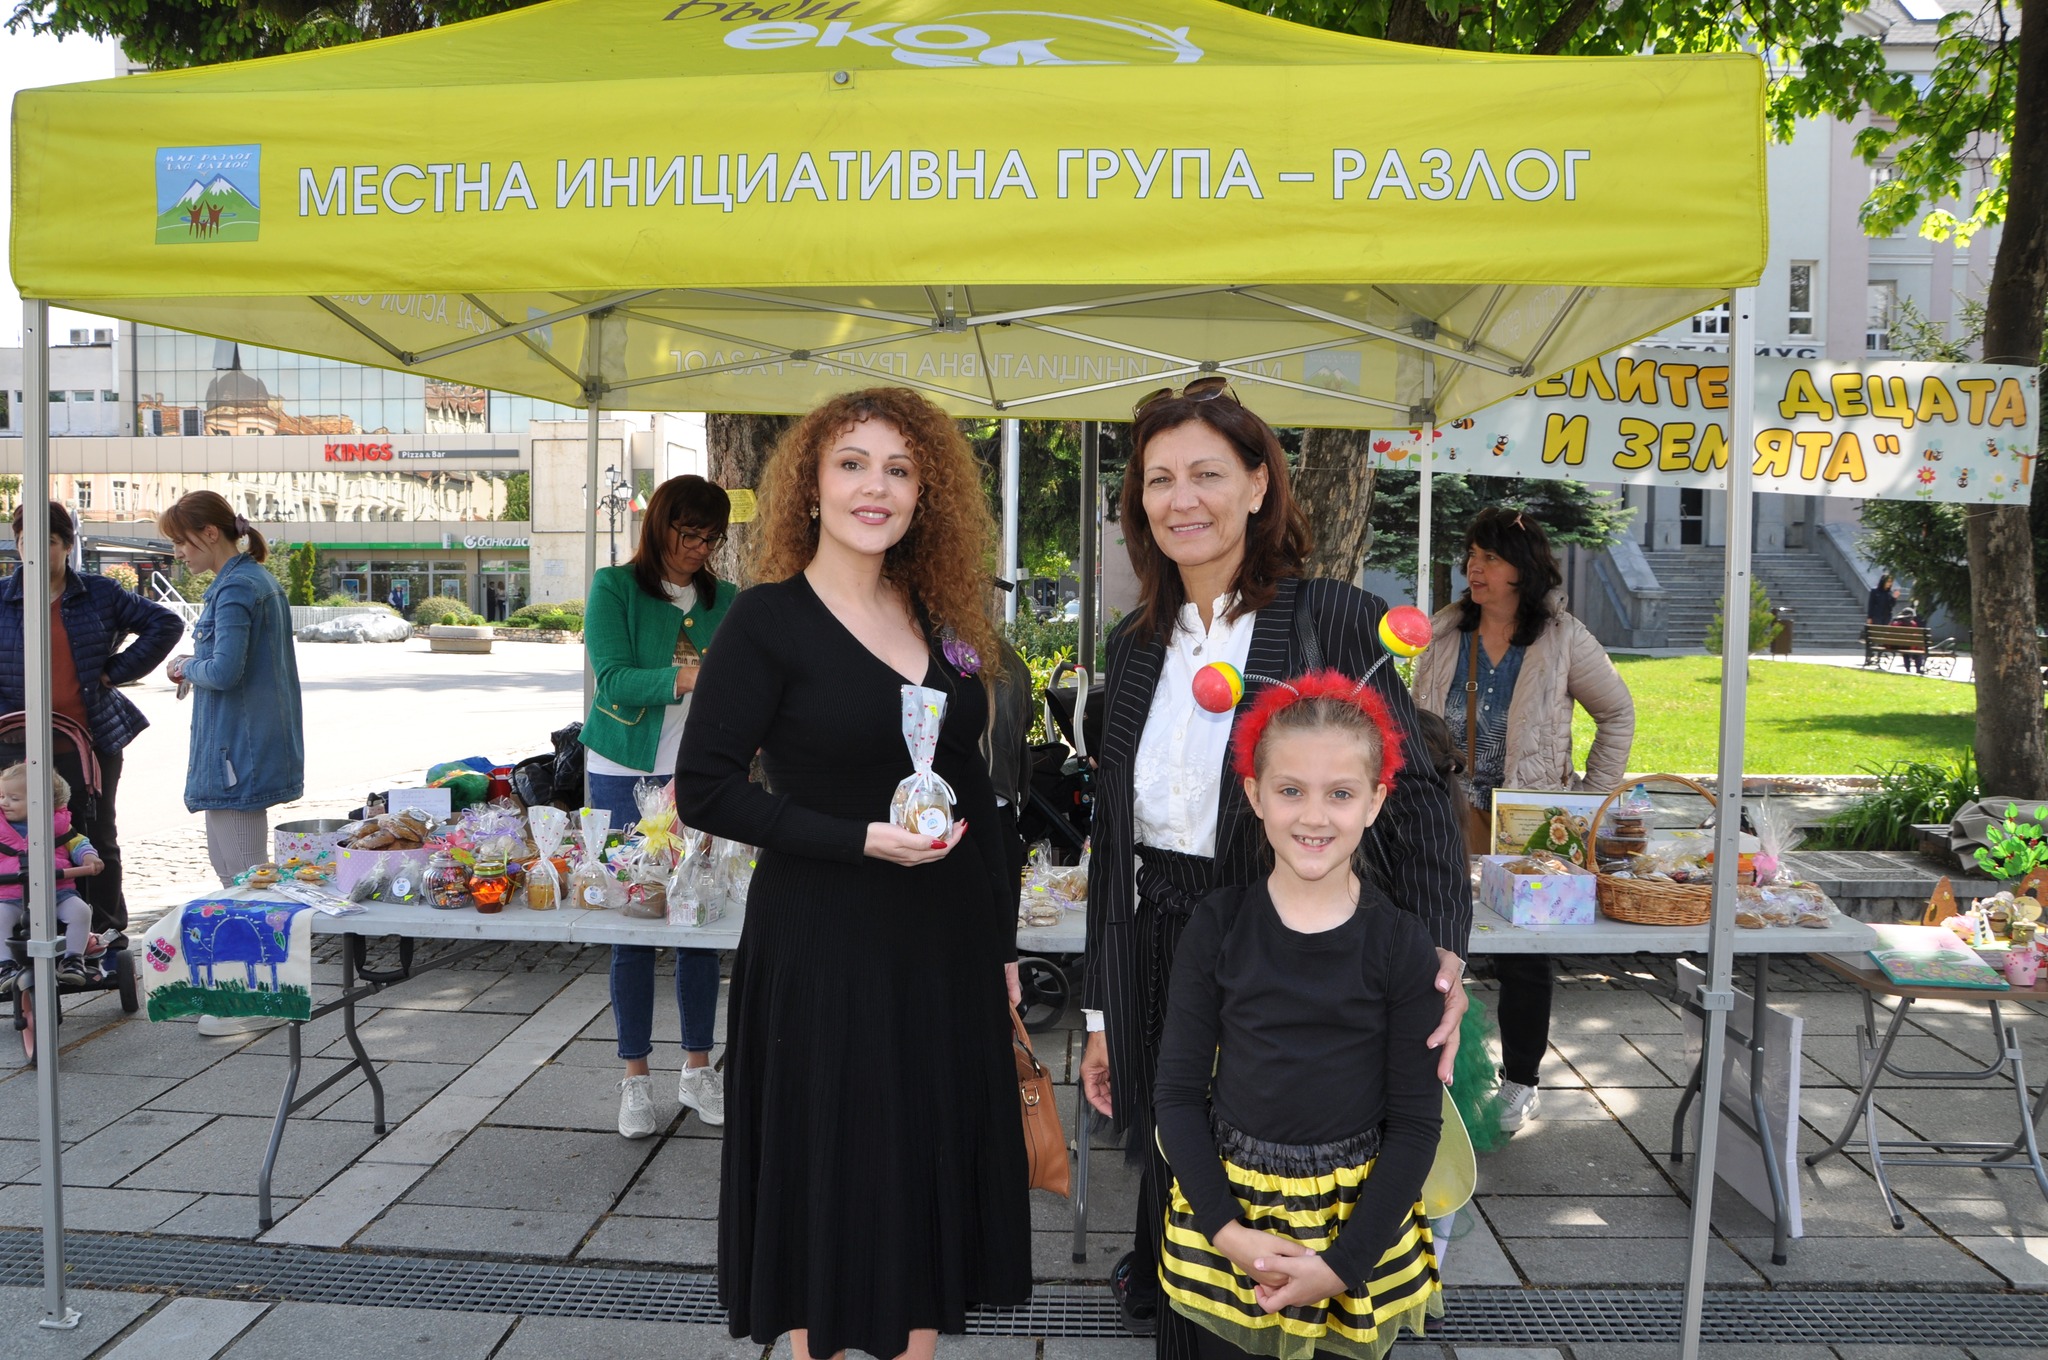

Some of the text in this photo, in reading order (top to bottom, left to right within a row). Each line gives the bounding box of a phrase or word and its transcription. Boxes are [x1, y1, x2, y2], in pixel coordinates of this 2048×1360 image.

[298, 161, 538, 217] МЕСТНА
[556, 149, 1037, 213] ИНИЦИАТИВНА
[1057, 147, 1265, 199] ГРУПА
[1332, 148, 1591, 201] РАЗЛОГ
[1778, 369, 2027, 428] ДЕЦАТА
[324, 443, 393, 462] KINGS
[1541, 413, 1589, 465] И
